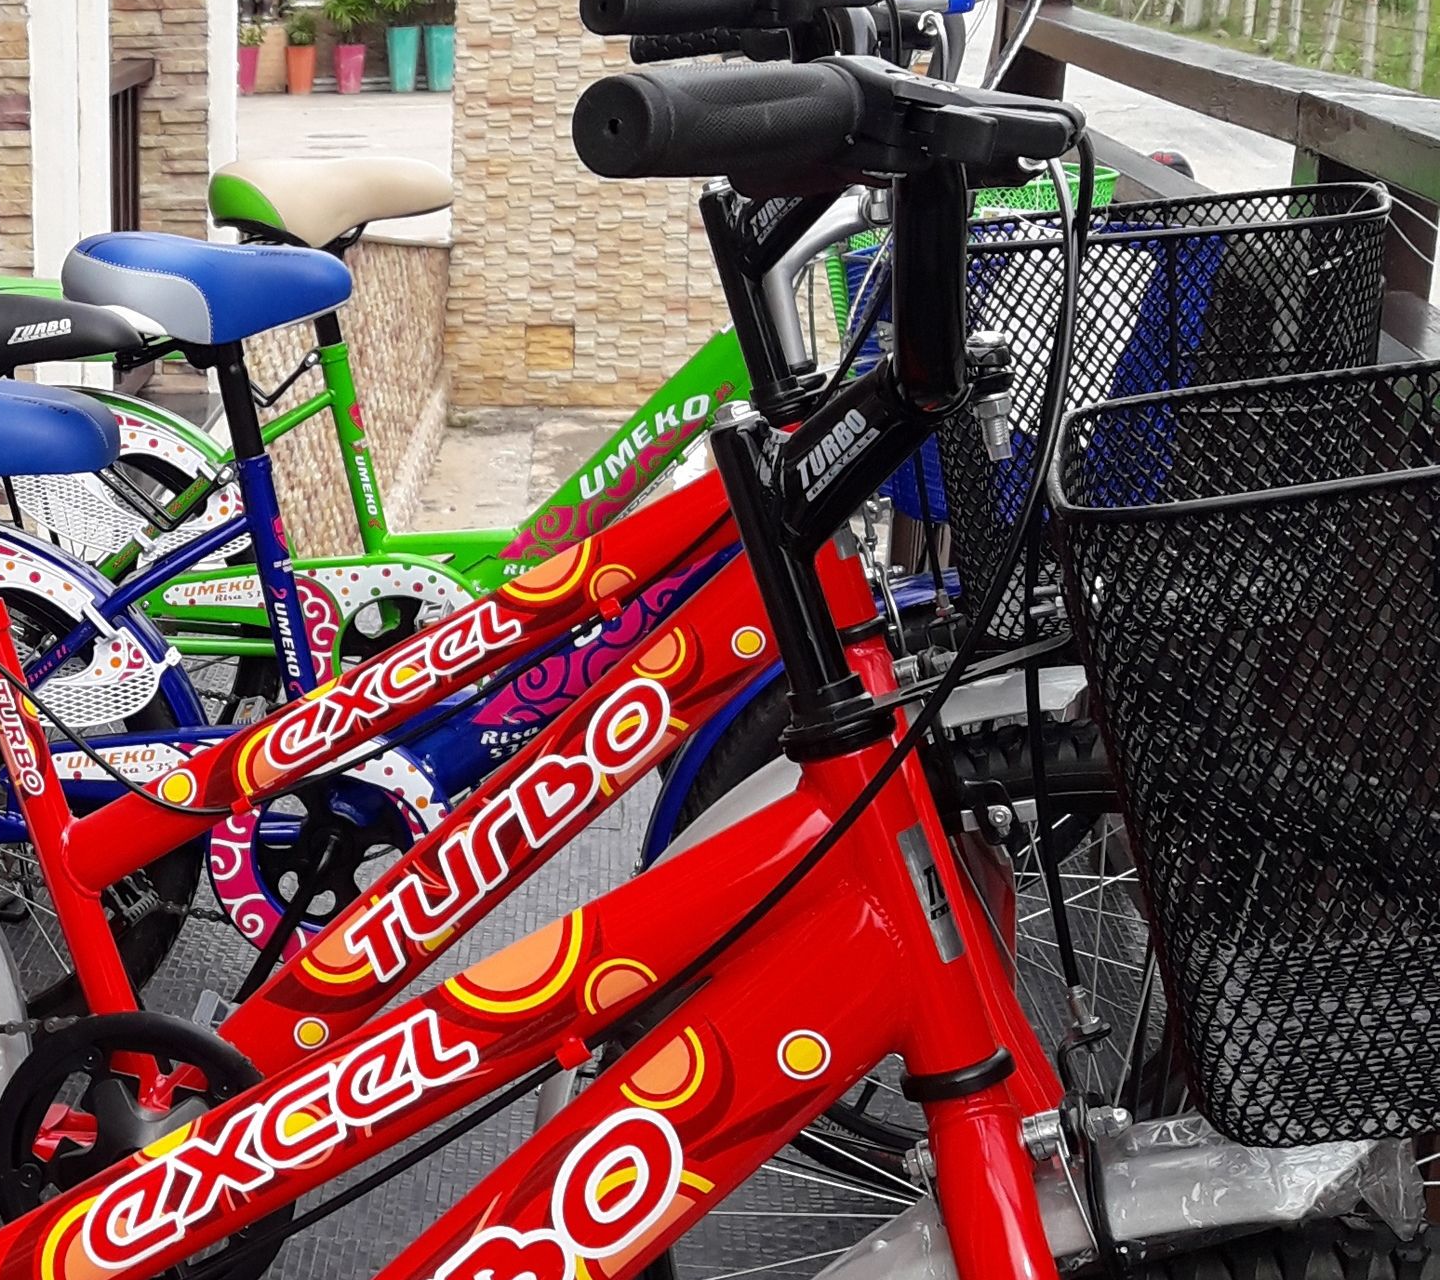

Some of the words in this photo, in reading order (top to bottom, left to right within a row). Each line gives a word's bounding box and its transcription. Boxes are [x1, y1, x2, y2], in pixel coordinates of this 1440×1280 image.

[750, 197, 787, 237] TURB
[11, 318, 72, 339] TURBO
[579, 394, 710, 500] UMEKO
[796, 409, 867, 490] TURBO
[354, 455, 379, 516] UMEKO
[183, 580, 255, 597] UMEKO
[273, 602, 301, 678] UMEKO
